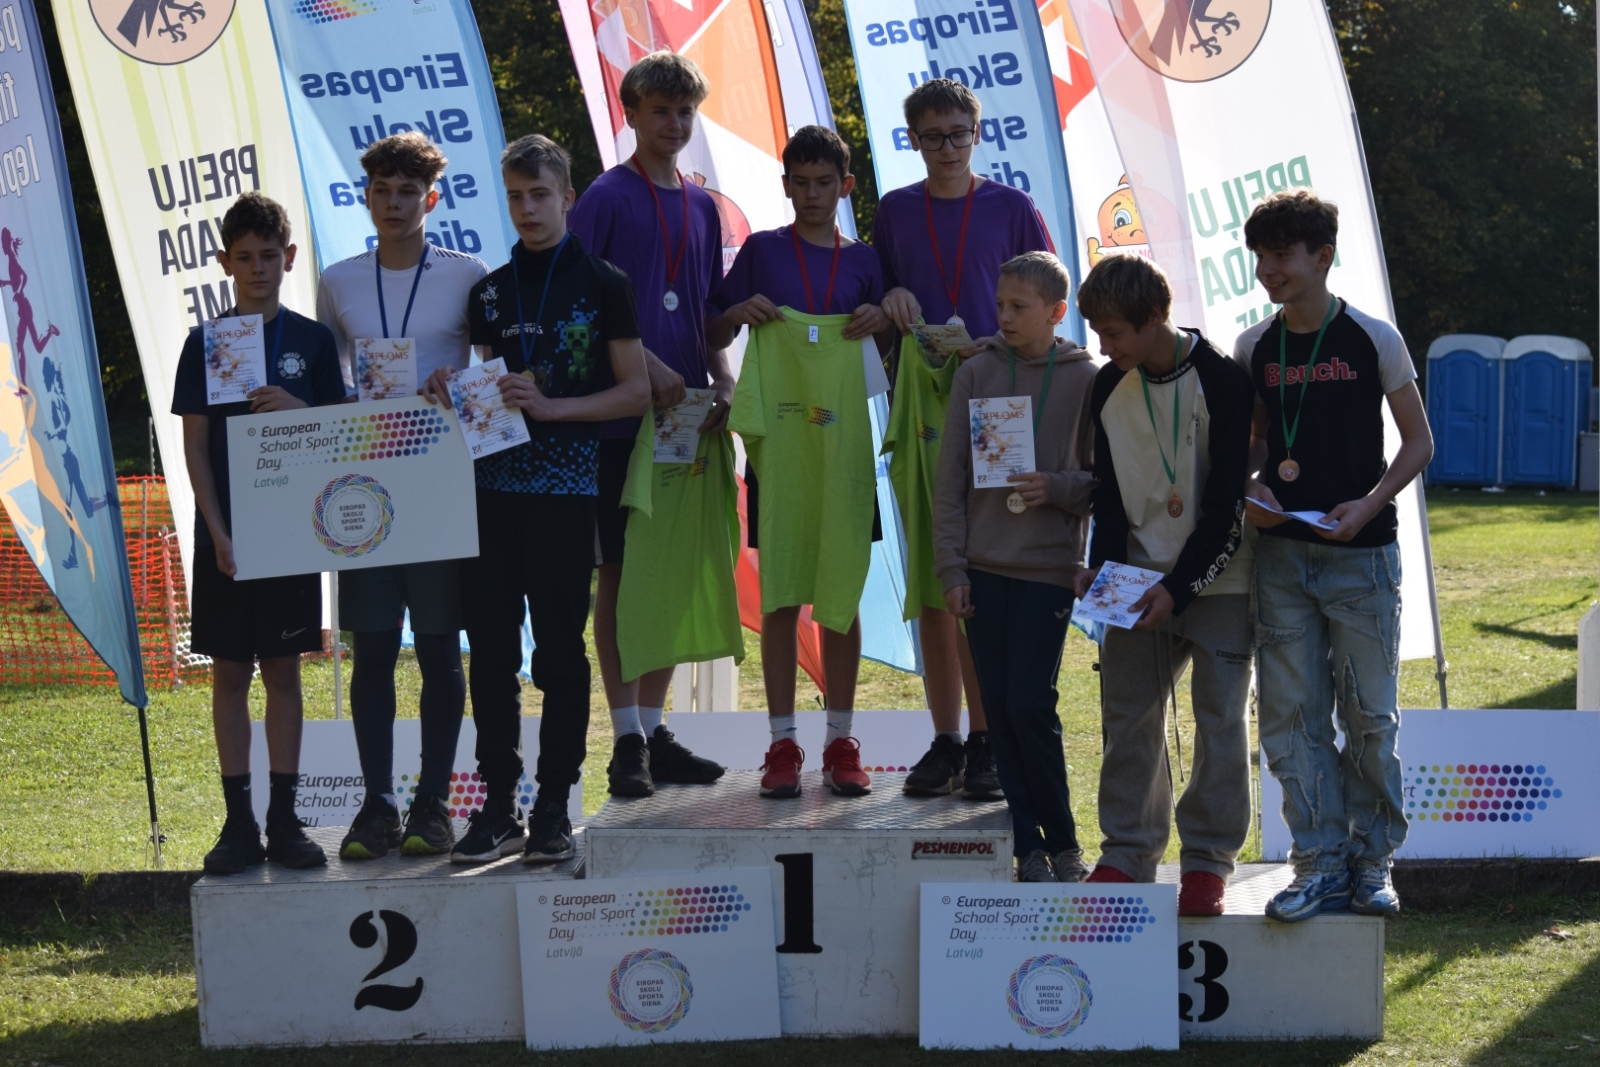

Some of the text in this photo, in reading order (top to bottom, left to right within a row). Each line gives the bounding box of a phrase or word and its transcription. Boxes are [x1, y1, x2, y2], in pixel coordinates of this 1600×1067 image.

[212, 327, 257, 340] DIPLOMS
[364, 351, 409, 361] DIPLOMS
[1264, 357, 1357, 387] Bench.
[978, 410, 1025, 421] DIPLOMS
[261, 420, 321, 438] European
[259, 434, 340, 455] School Sport
[256, 456, 282, 473] Day
[253, 474, 289, 489] Latvijā
[339, 503, 366, 512] EIROPAS
[342, 510, 364, 518] SKOLU
[341, 517, 366, 525] SPORTA
[1106, 571, 1152, 587] DIPLOMS
[297, 773, 365, 791] Europea
[294, 792, 348, 808] School
[913, 841, 994, 855] PESMENPOL
[553, 893, 616, 908] European
[774, 852, 823, 954] 1
[956, 895, 1021, 910] European
[551, 907, 636, 923] School Sport
[954, 911, 1040, 927] School Sport
[548, 927, 575, 942] Day
[949, 928, 977, 943] Day
[546, 945, 583, 959] Latvijā
[945, 947, 984, 960] Latvijā
[349, 909, 424, 1012] 2
[1177, 939, 1230, 1023] 3
